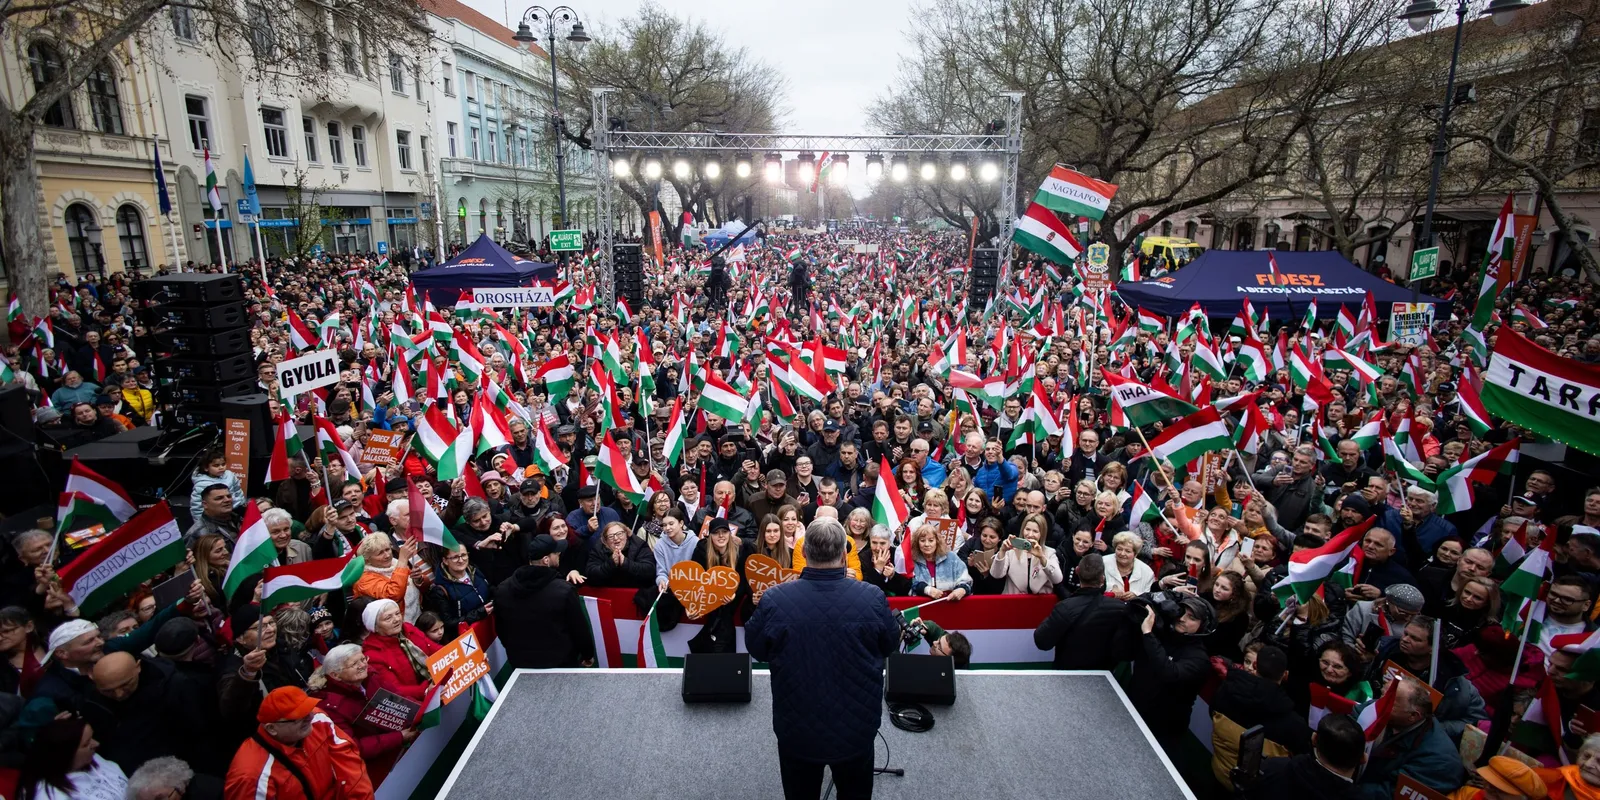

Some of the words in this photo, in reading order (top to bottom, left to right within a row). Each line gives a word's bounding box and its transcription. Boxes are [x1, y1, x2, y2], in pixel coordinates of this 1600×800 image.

[1051, 182, 1101, 204] NAGYLAPOS
[1418, 267, 1428, 276] EXIT
[475, 290, 552, 304] OROSHÁZA
[281, 358, 336, 388] GYULA
[370, 434, 390, 444] FIDESZ
[363, 454, 394, 464] VÁLASZTÁ
[670, 567, 738, 589] HALLGASS
[746, 559, 800, 583] SZAVA
[698, 585, 705, 593] A
[431, 648, 460, 675] FIDESZ
[444, 662, 487, 699] VÁLASZTÁS
[365, 714, 380, 724] NEM
[1400, 785, 1430, 800] FID
